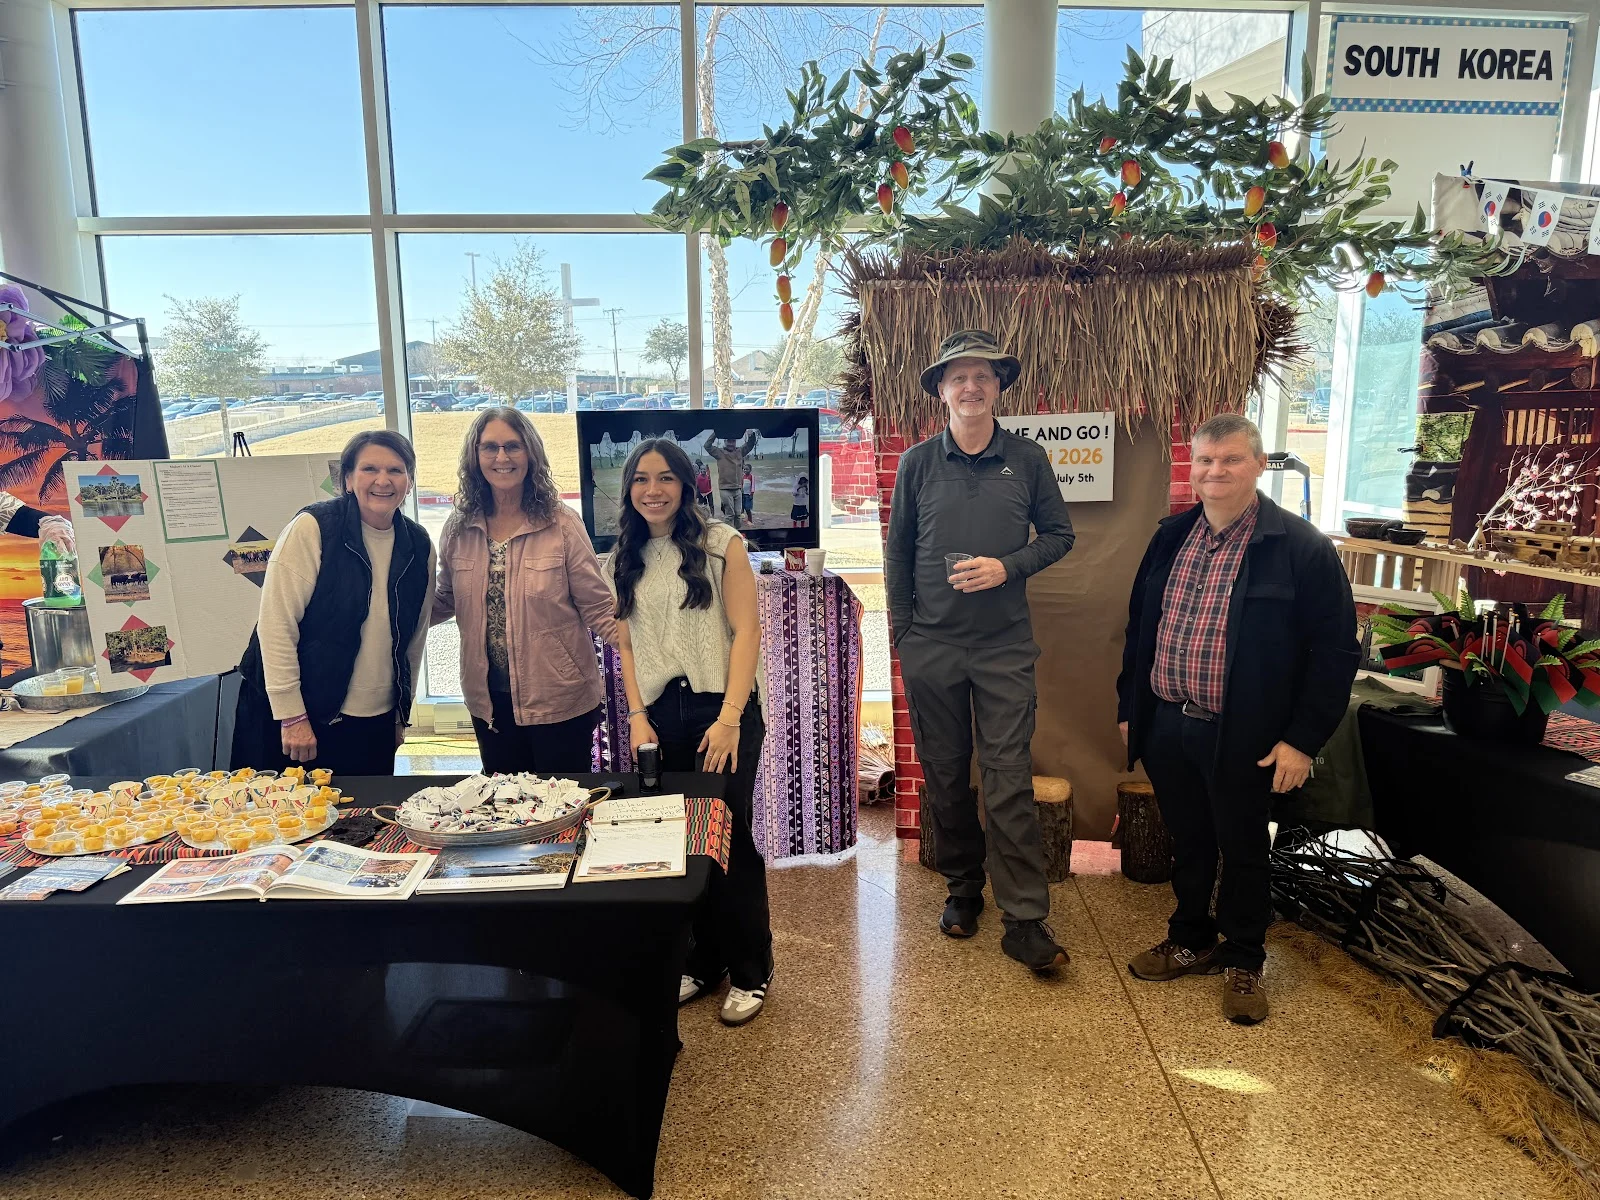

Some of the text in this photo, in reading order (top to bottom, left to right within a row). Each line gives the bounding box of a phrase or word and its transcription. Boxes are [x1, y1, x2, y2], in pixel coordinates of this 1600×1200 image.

[1343, 44, 1553, 81] SOUTH KOREA
[1035, 426, 1072, 441] AND
[1076, 425, 1101, 440] GO
[1058, 447, 1103, 465] 2026
[1056, 473, 1095, 485] July 5th
